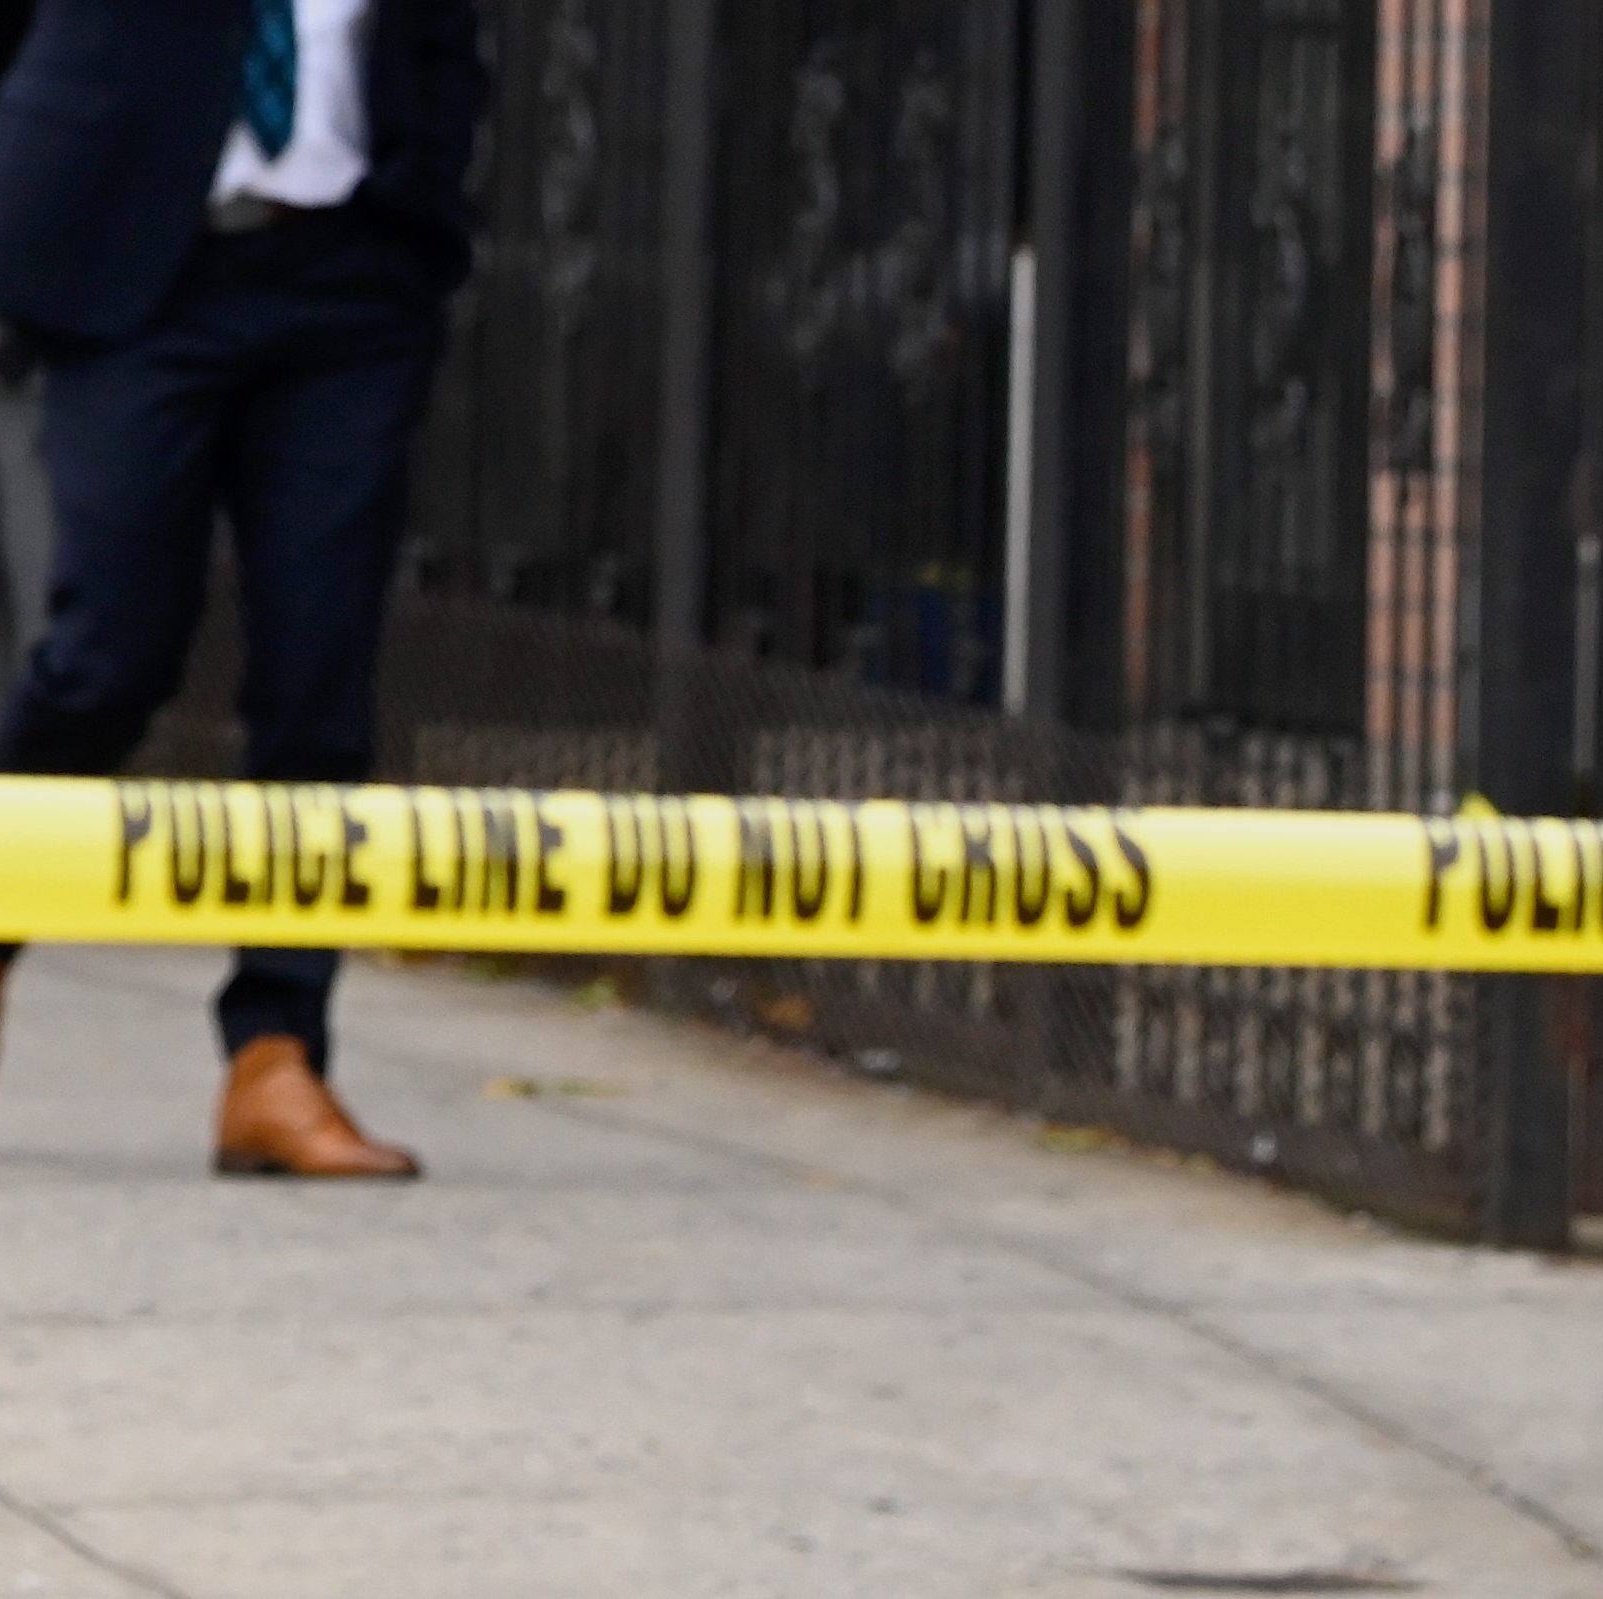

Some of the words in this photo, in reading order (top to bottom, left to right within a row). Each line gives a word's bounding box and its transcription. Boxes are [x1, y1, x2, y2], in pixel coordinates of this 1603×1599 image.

[112, 784, 370, 910] POLICE
[407, 788, 568, 916] LINE
[602, 794, 698, 920] DO
[733, 797, 868, 926] NOT
[905, 803, 1155, 932] CROSS
[1422, 816, 1603, 935] POLI
